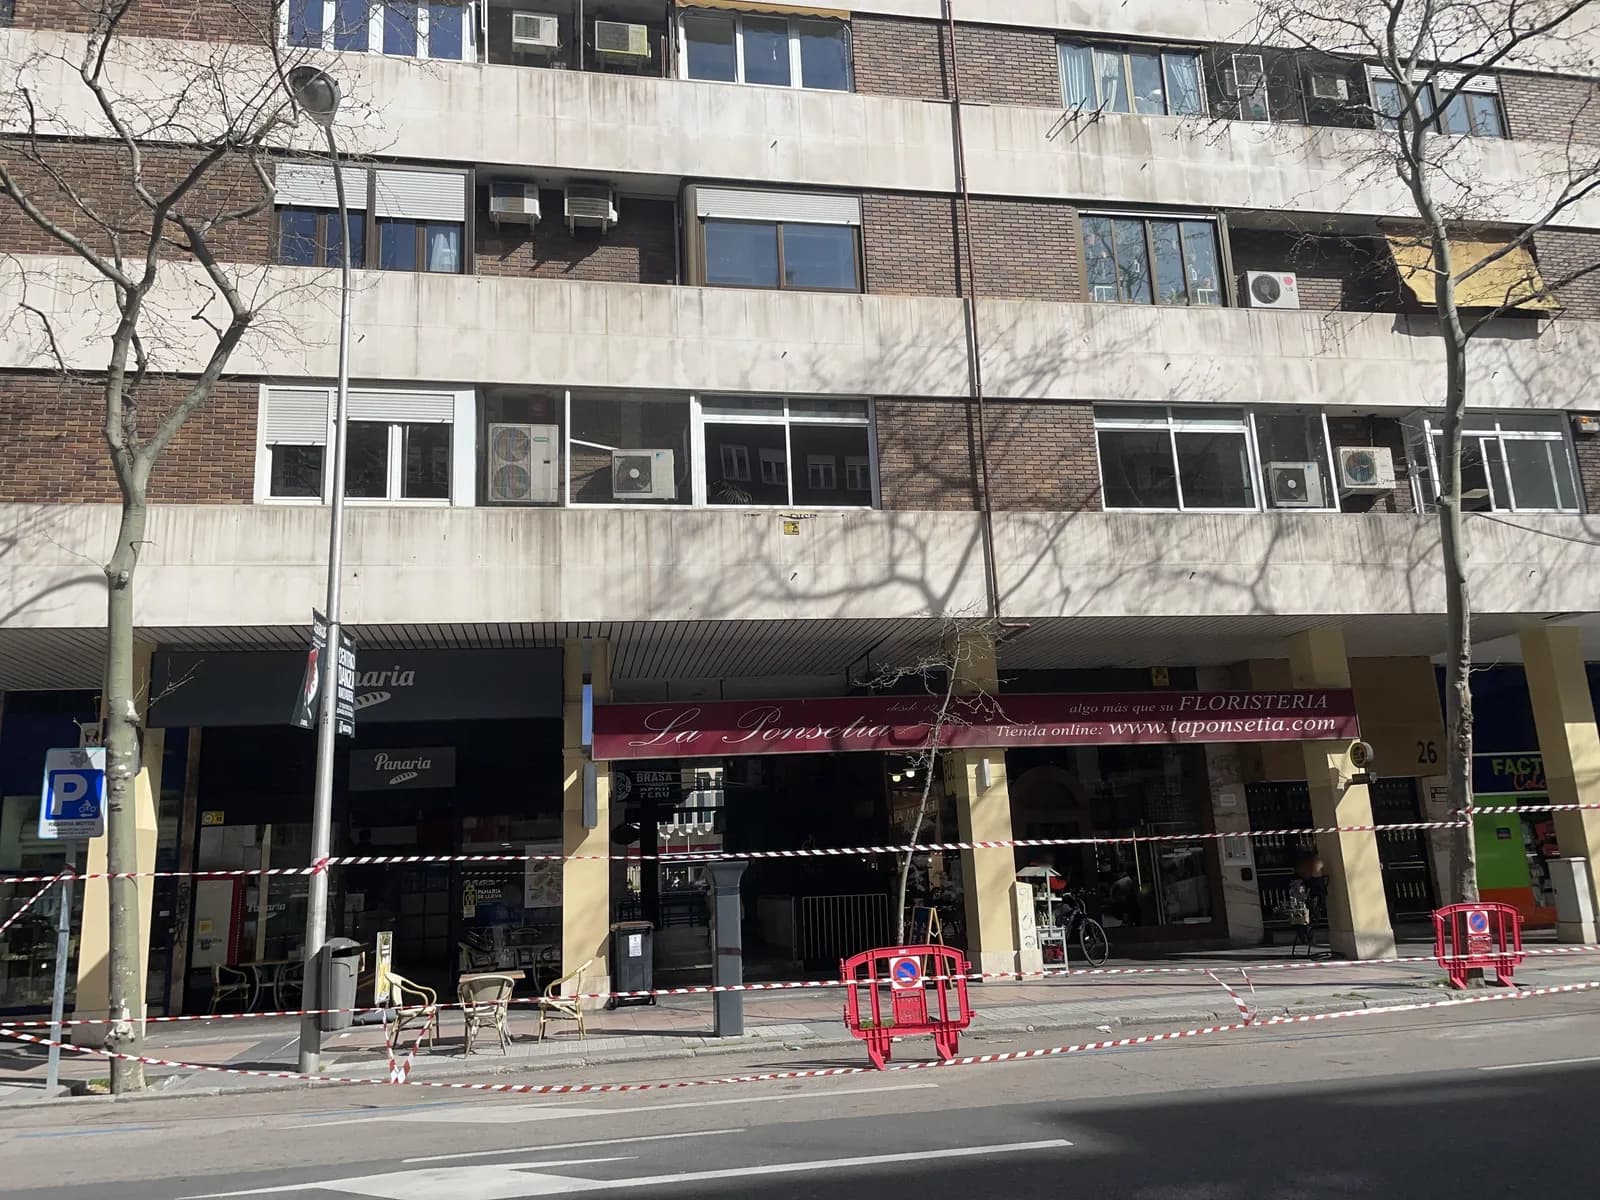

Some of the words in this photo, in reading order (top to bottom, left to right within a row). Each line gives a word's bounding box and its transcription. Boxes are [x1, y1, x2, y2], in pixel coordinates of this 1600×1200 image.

[1069, 703, 1099, 716] algo
[1102, 702, 1129, 713] más
[1132, 704, 1157, 715] que
[1159, 704, 1174, 712] su
[1179, 694, 1328, 712] FLORISTERIA
[628, 705, 703, 747] La
[721, 704, 893, 744] Ponsetia
[996, 724, 1047, 737] Tienda
[1050, 724, 1104, 737] online:
[1109, 717, 1336, 739] www.laponsetia.com
[374, 751, 432, 771] Panaria
[1417, 741, 1438, 764] 26
[636, 772, 673, 783] BRASA
[51, 774, 88, 816] P
